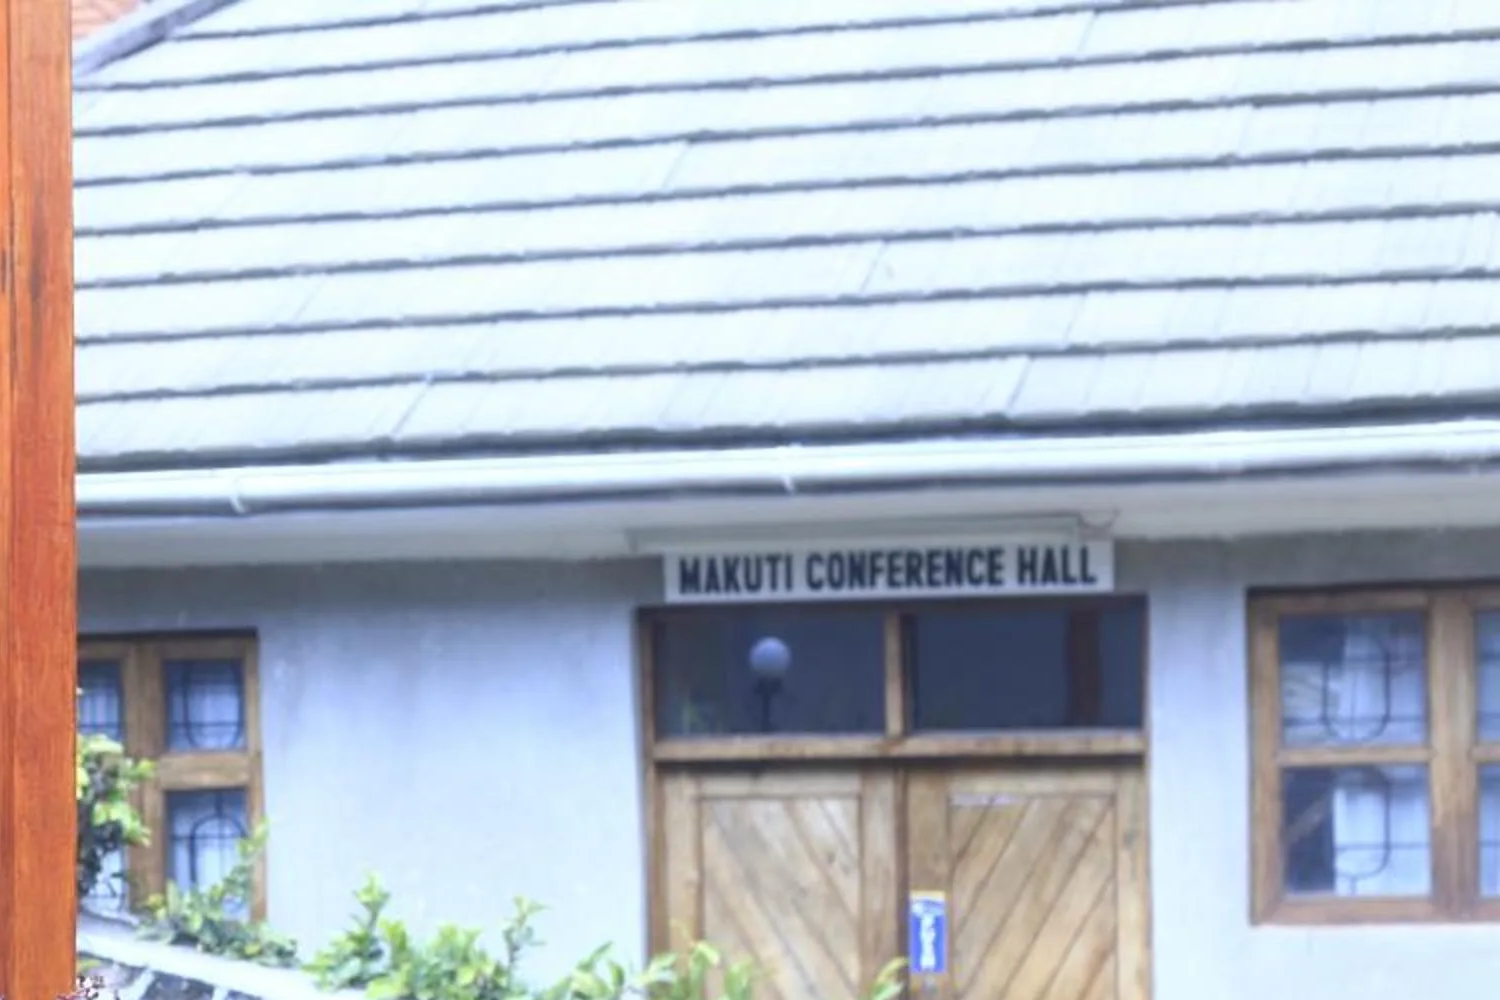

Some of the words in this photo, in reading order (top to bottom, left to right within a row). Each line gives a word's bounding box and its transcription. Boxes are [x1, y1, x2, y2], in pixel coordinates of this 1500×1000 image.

[678, 553, 794, 595] MAKUTI
[805, 546, 1006, 591] CONFERENCE
[1016, 544, 1098, 586] HALL
